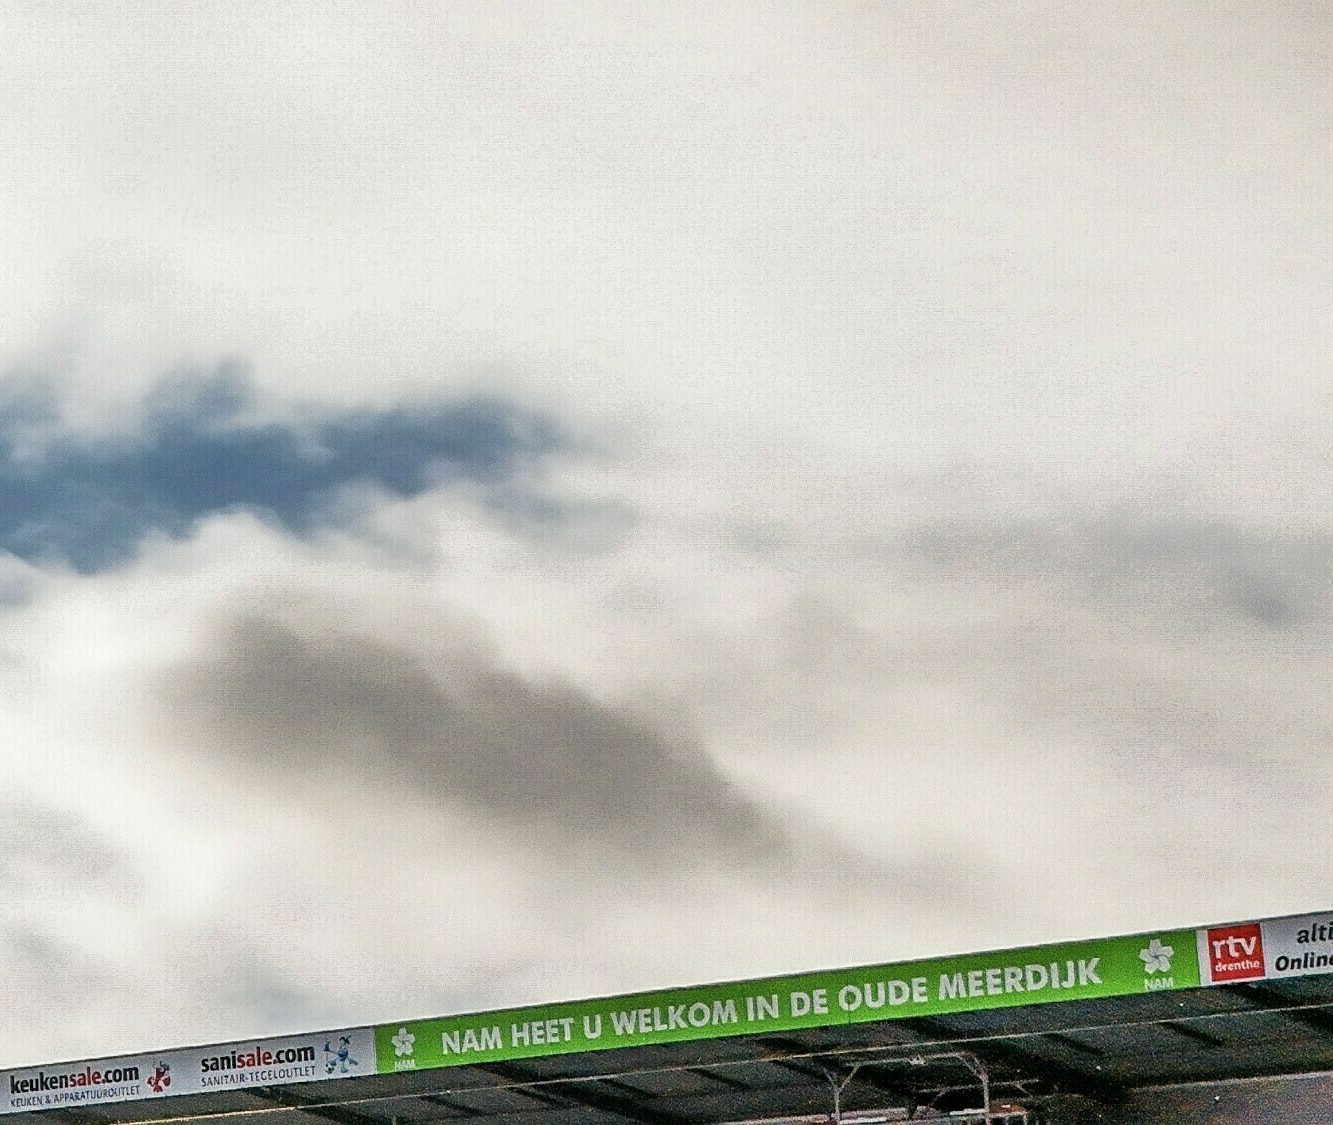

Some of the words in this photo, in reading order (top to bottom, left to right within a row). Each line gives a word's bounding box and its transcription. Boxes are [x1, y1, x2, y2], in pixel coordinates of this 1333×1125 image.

[1212, 935, 1257, 959] rtv
[1215, 960, 1260, 972] drenthe
[1275, 952, 1333, 971] Onlin
[1144, 976, 1174, 992] NAM
[440, 1025, 503, 1056] NAM
[511, 1016, 573, 1048] HEET
[583, 1013, 603, 1039] U
[609, 999, 738, 1037] WELKOM
[746, 994, 779, 1022] IN
[790, 988, 829, 1018] DE
[838, 976, 928, 1011] OUDE
[938, 957, 1103, 1000] MEERDIJK
[201, 1045, 315, 1073] sanisale.com
[10, 1066, 139, 1094] keukensale.com
[201, 1066, 316, 1088] SANITAIR-TEGELOUTLET
[10, 1095, 43, 1108] KEUKEN
[45, 1095, 51, 1105] &
[53, 1085, 140, 1104] APPARATUUROUTLET
